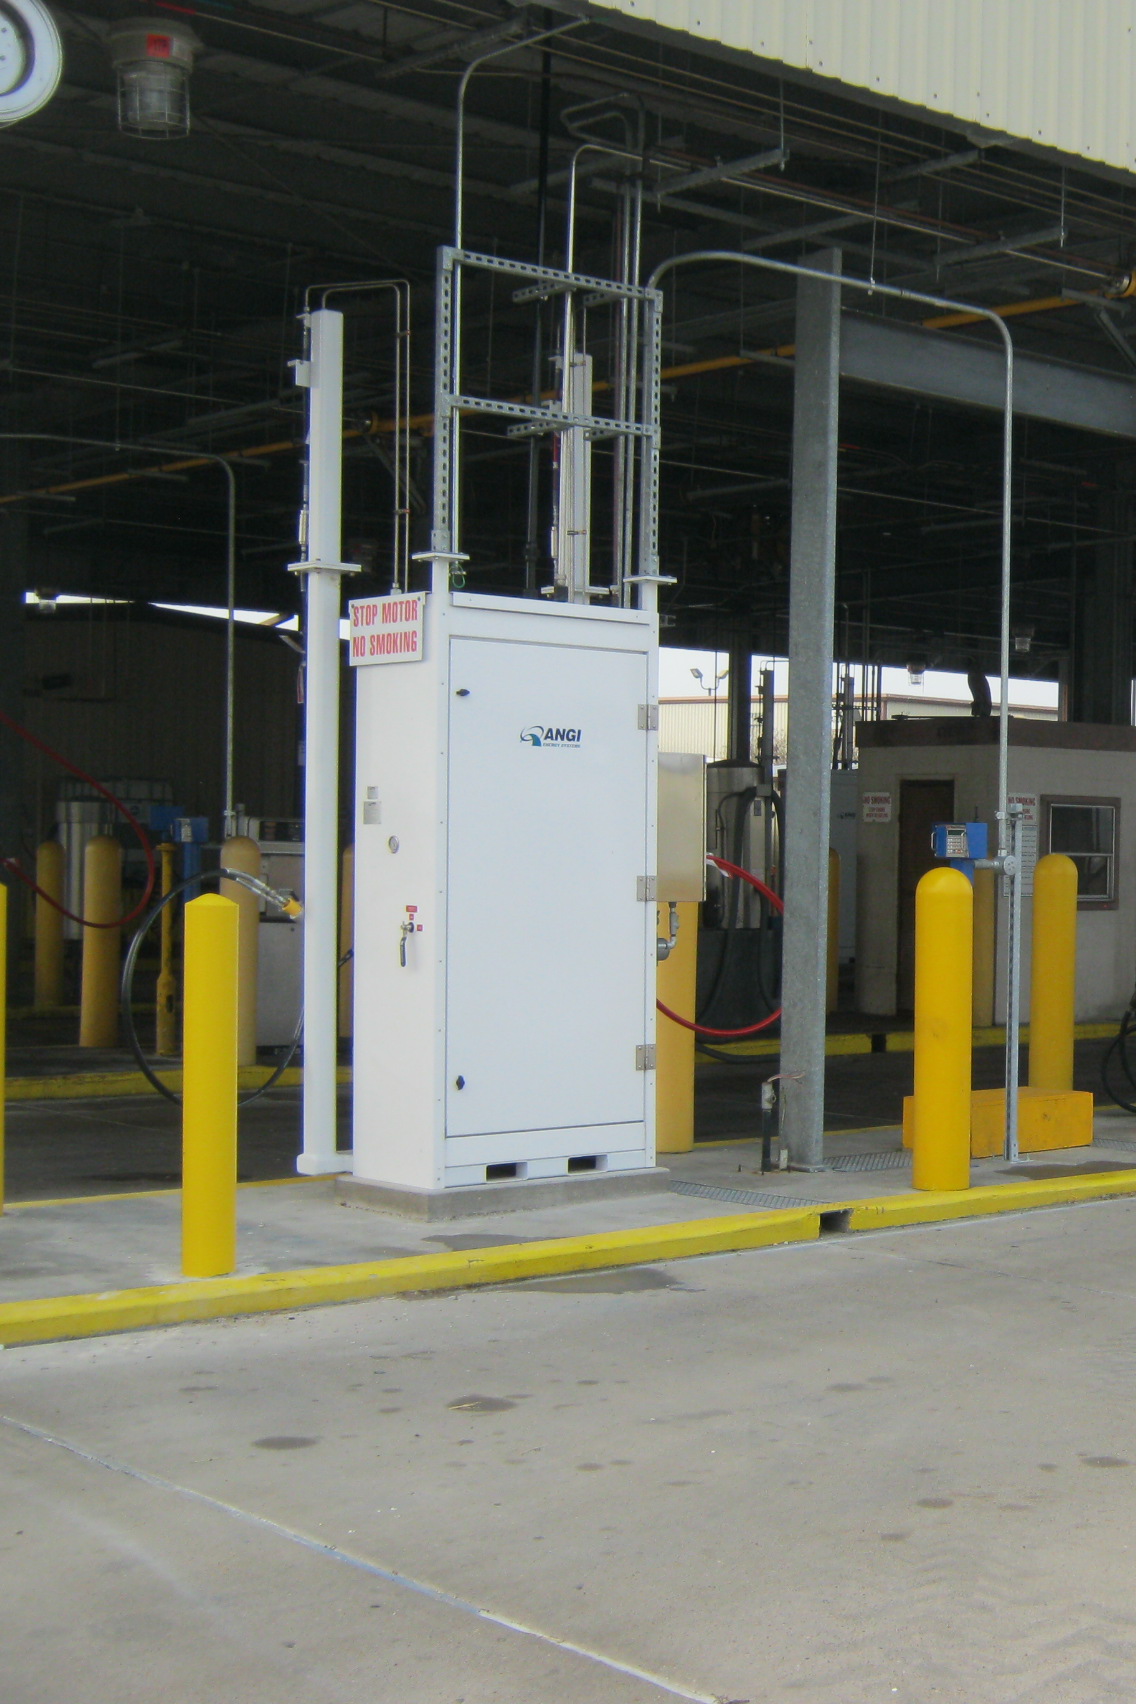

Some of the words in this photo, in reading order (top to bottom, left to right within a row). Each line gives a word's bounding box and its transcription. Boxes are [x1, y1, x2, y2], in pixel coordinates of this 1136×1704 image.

[353, 604, 378, 628] STOP
[381, 599, 418, 625] MOTOR
[352, 635, 367, 658] NO
[369, 630, 418, 656] SMOKING
[543, 727, 582, 742] ANGI
